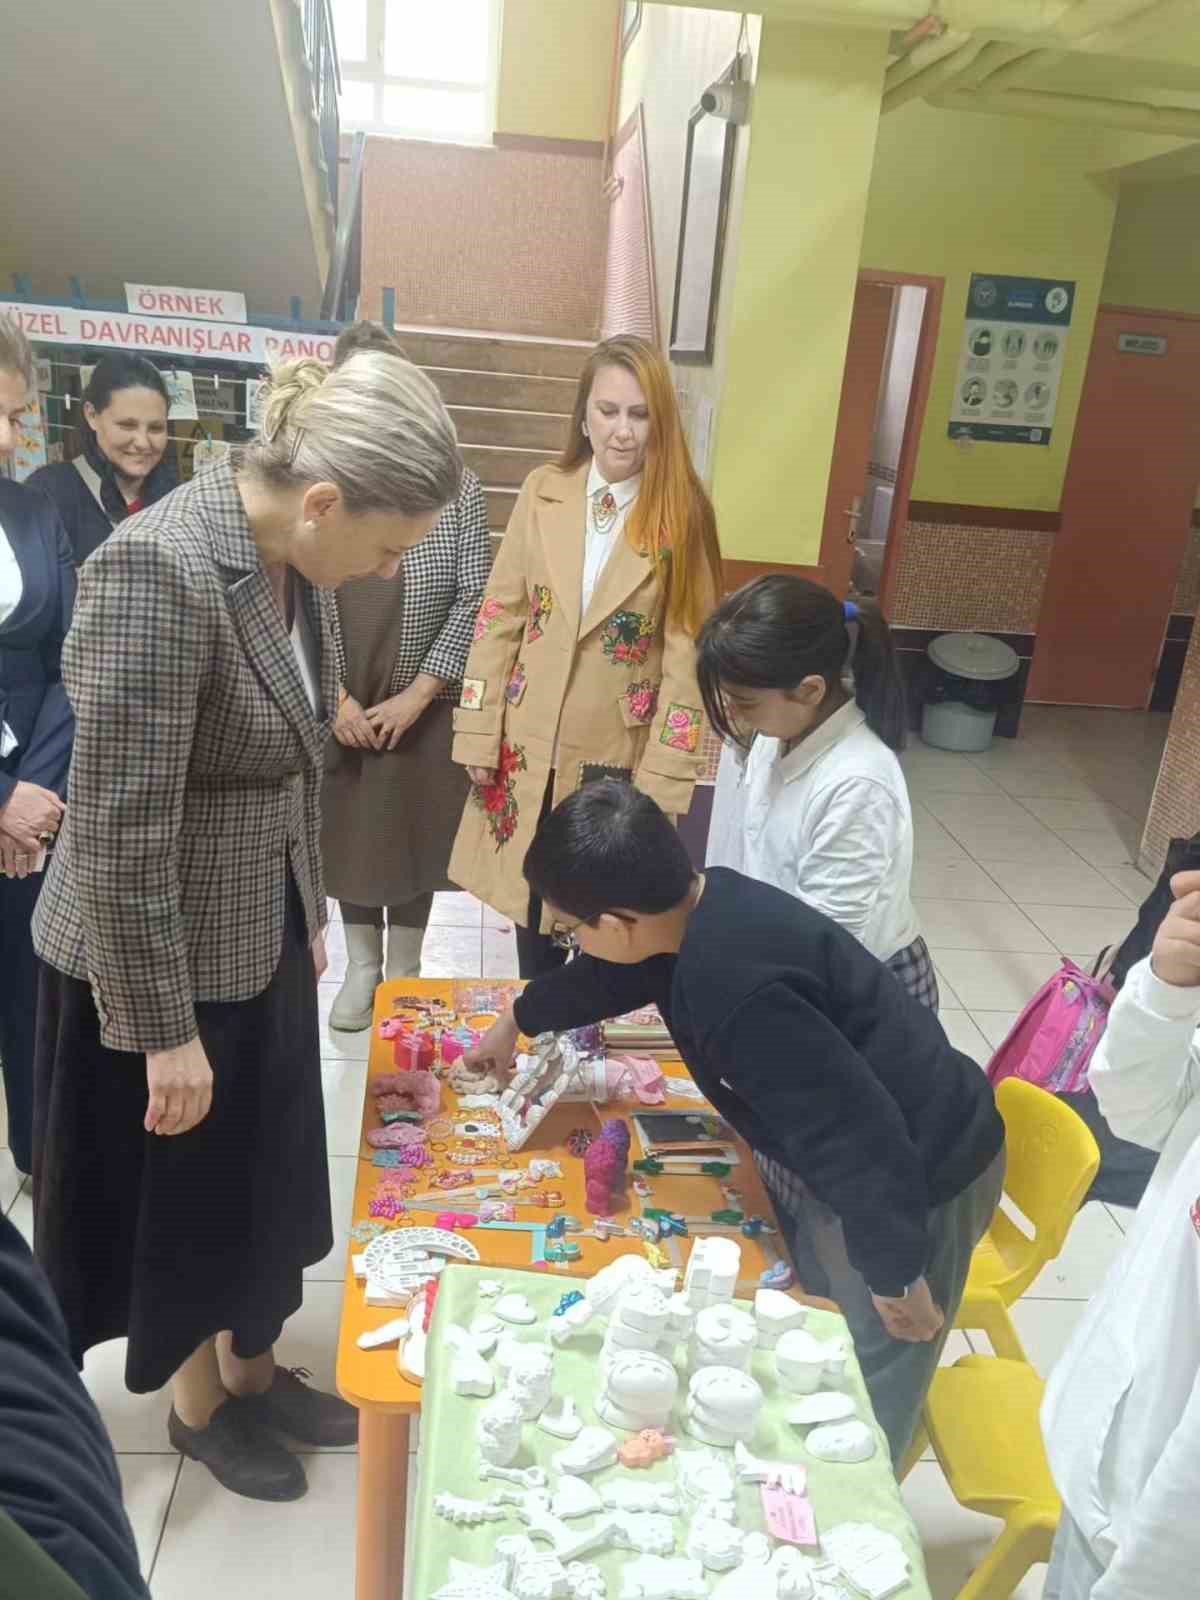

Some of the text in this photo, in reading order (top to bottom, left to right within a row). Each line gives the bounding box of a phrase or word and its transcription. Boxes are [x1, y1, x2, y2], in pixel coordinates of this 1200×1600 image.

[138, 288, 225, 315] ÖRNEK
[7, 305, 336, 362] ÜZEL DAVRANIŞLAR PANO
